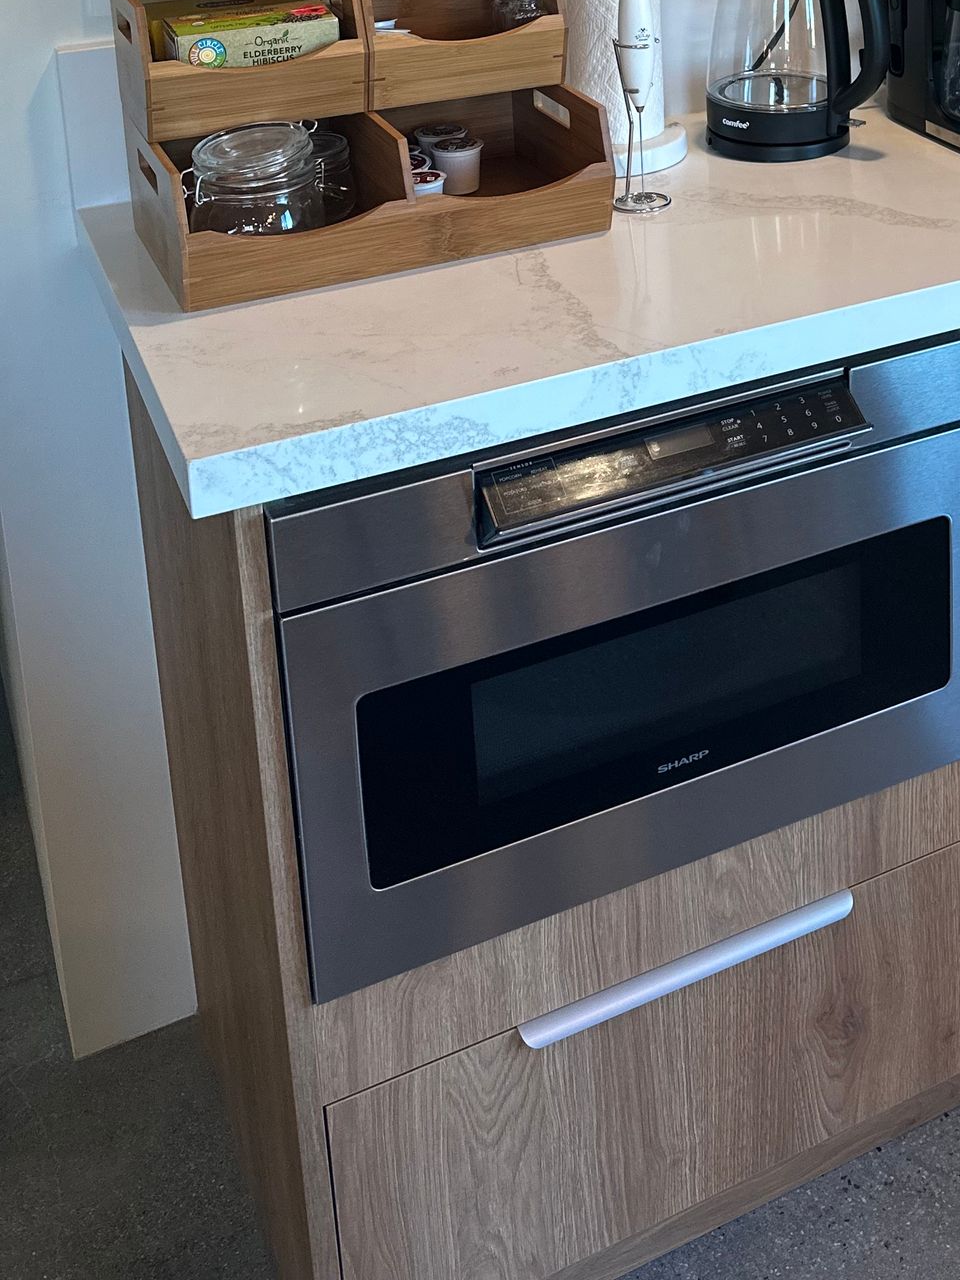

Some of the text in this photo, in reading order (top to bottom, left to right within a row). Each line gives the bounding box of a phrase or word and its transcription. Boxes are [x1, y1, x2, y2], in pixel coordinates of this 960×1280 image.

[197, 40, 224, 54] CIRCLE
[254, 35, 289, 48] Organic
[243, 45, 303, 59] ELDERBERRY
[252, 54, 295, 67] HIBISCUS
[774, 403, 782, 411] 2
[805, 409, 812, 417] 6
[835, 415, 842, 423] 0
[727, 434, 744, 443] START
[762, 421, 818, 443] 7 8 9
[657, 749, 710, 774] SHARP
